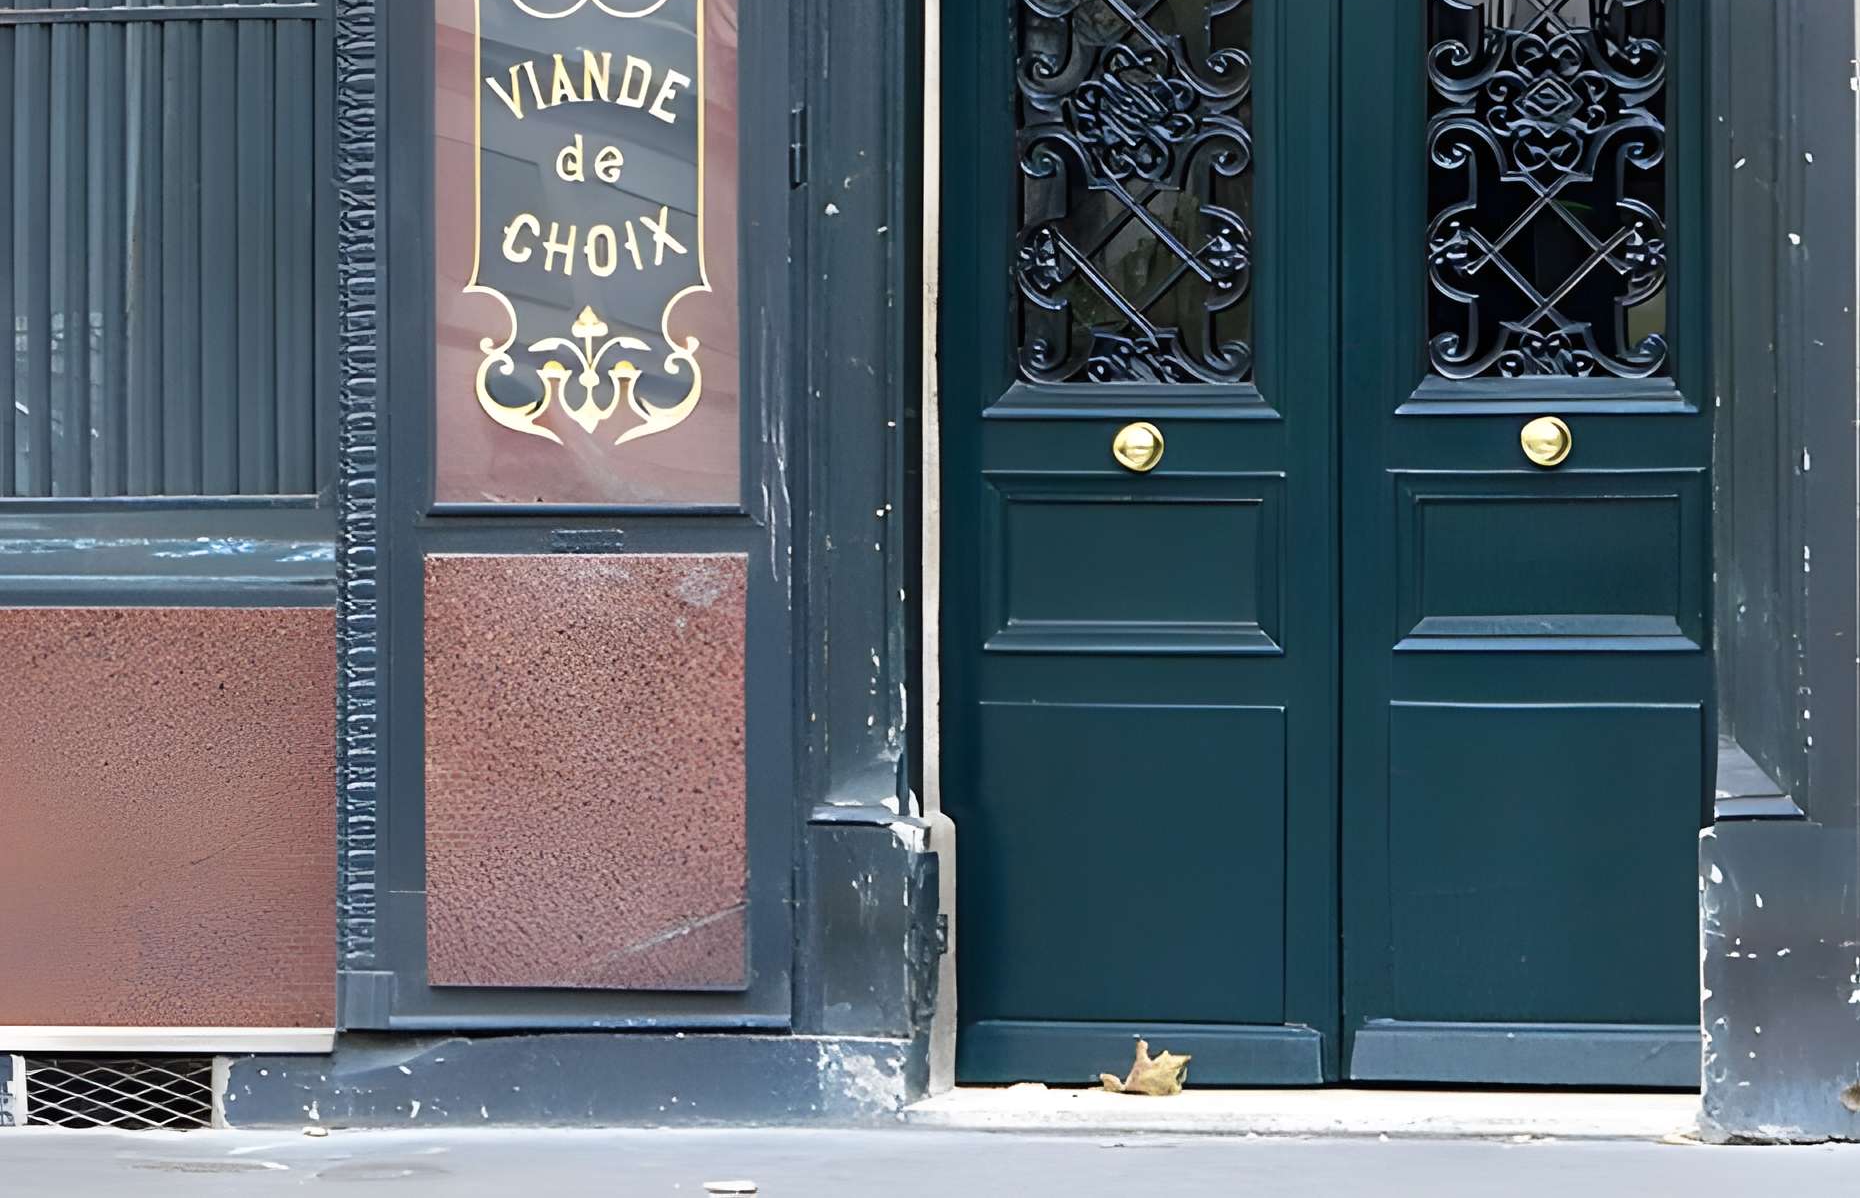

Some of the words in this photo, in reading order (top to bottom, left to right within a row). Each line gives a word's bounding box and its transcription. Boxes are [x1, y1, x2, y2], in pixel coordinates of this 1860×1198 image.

[486, 49, 691, 123] VIANDE
[556, 134, 624, 183] de
[502, 206, 688, 277] CHOIX
